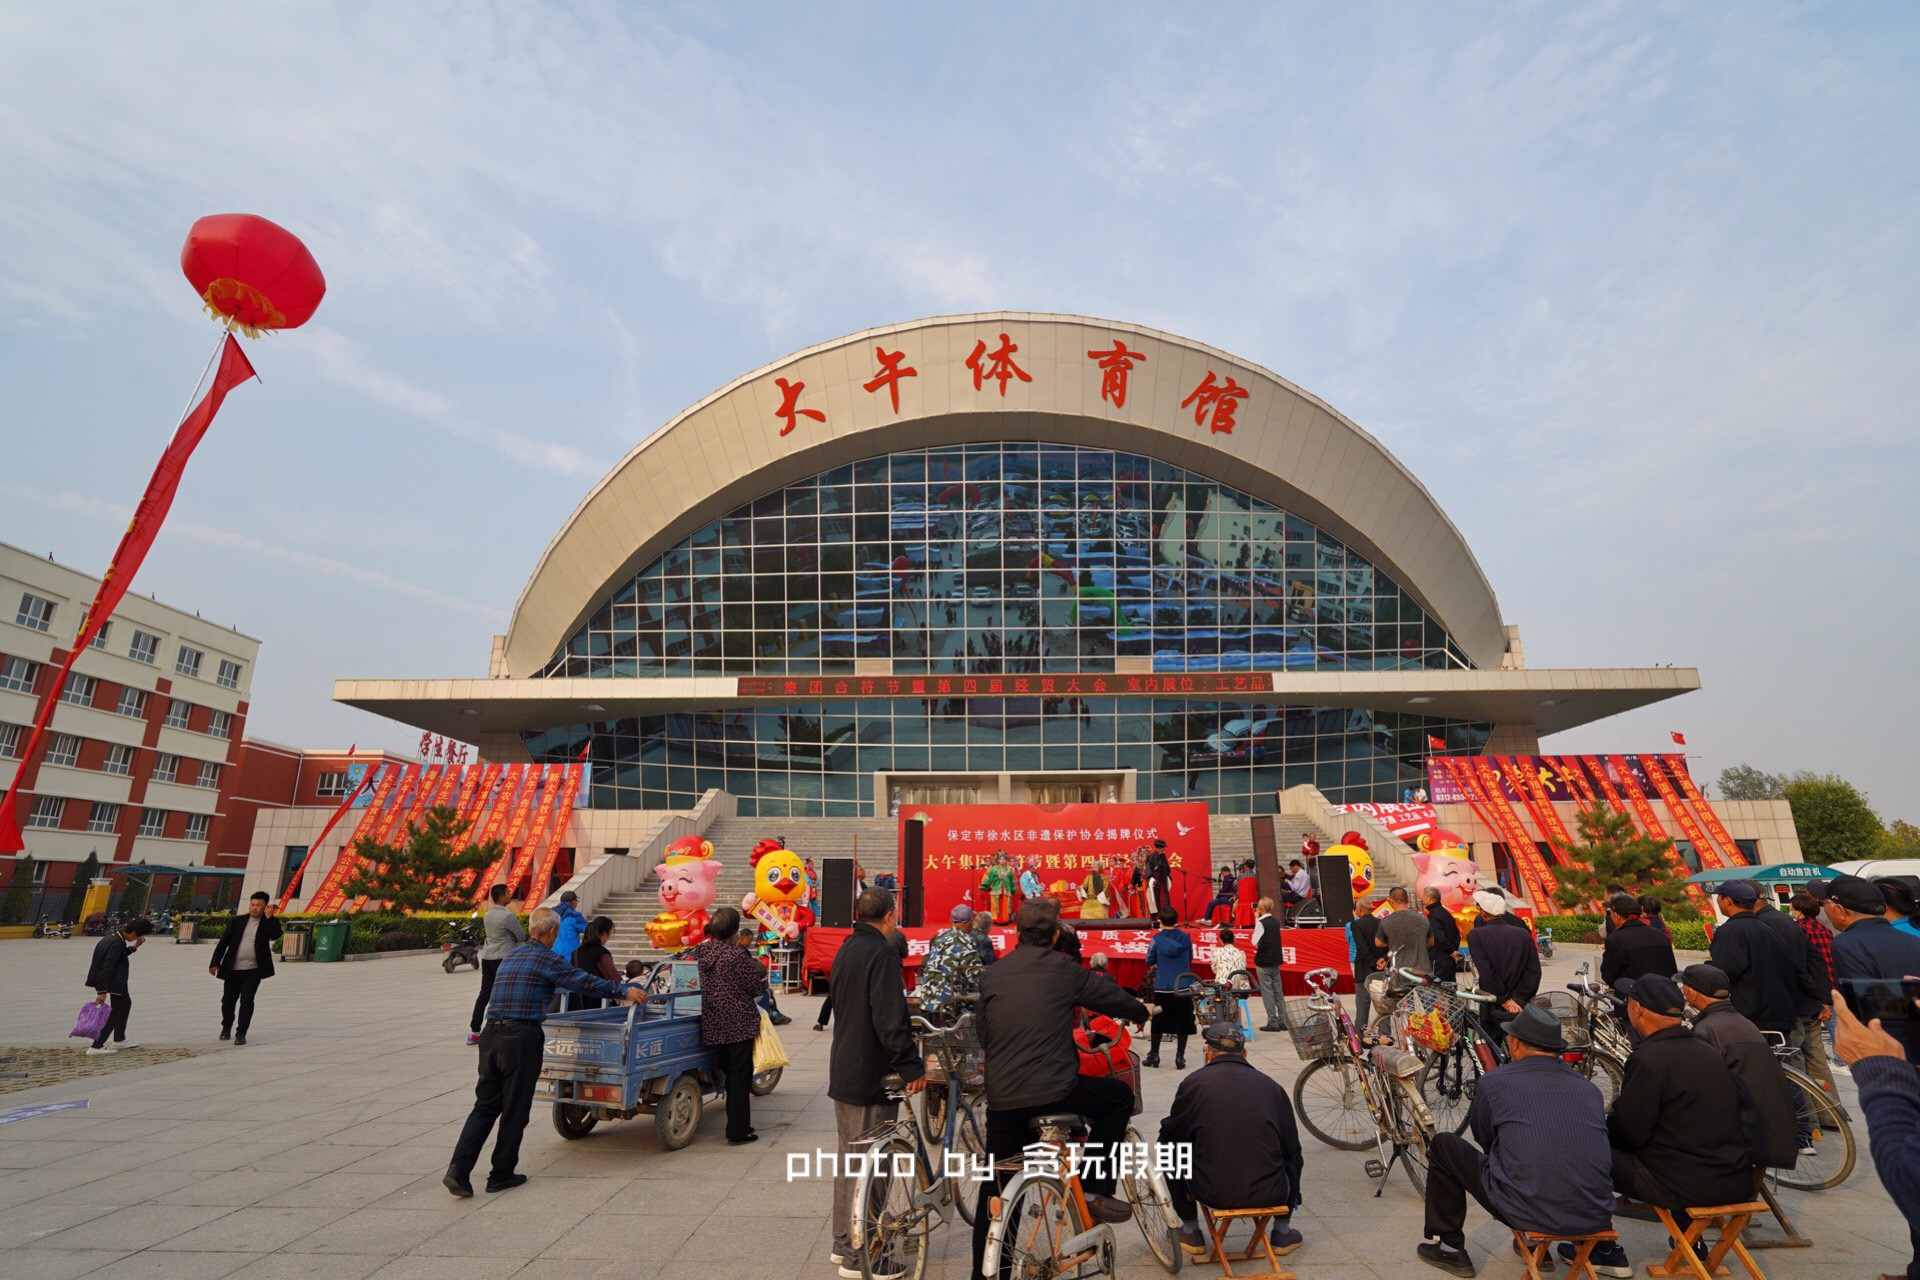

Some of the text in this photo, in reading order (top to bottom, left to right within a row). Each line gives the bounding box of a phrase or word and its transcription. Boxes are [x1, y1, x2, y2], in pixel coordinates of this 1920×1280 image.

[773, 333, 1250, 437] 大午体育馆
[784, 678, 1107, 694] 集团合符节暨第四届经贸大会
[420, 731, 468, 765] 学生餐厅
[947, 827, 1159, 842] 保定市徐水区非遗保护协会揭牌仪式
[1779, 867, 1821, 877] 自动售货机
[636, 1040, 663, 1059] 长远
